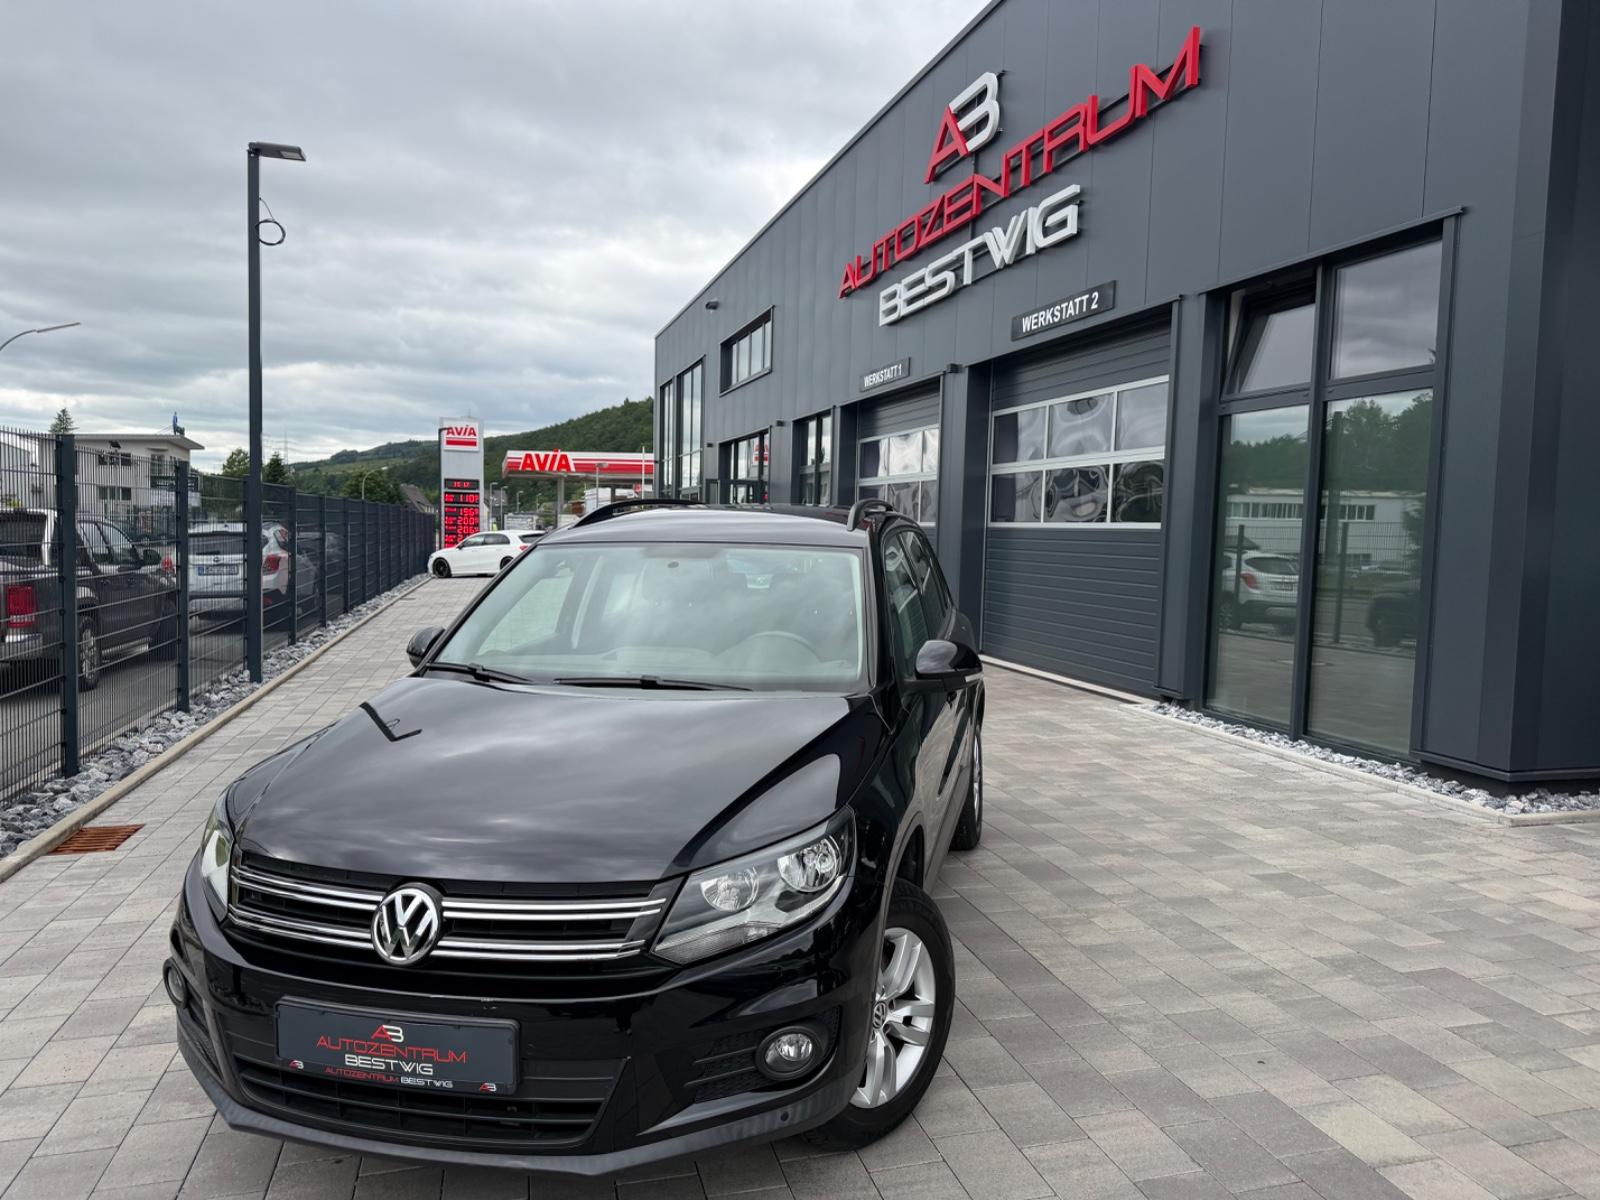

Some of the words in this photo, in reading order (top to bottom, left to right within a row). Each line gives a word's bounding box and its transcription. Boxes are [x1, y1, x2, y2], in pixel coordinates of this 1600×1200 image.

[838, 25, 1201, 299] AUTOZENTRUM
[879, 184, 1081, 327] BESTWIG
[1022, 294, 1089, 333] WERKSTATT
[1090, 291, 1099, 310] 2
[863, 364, 898, 388] WERKSTATT
[316, 1035, 467, 1064] AUTOZENTRUM
[344, 1053, 434, 1075] BESTWIG
[324, 1067, 399, 1083] AUTOZENTRUM
[400, 1076, 454, 1089] BESTWIG
